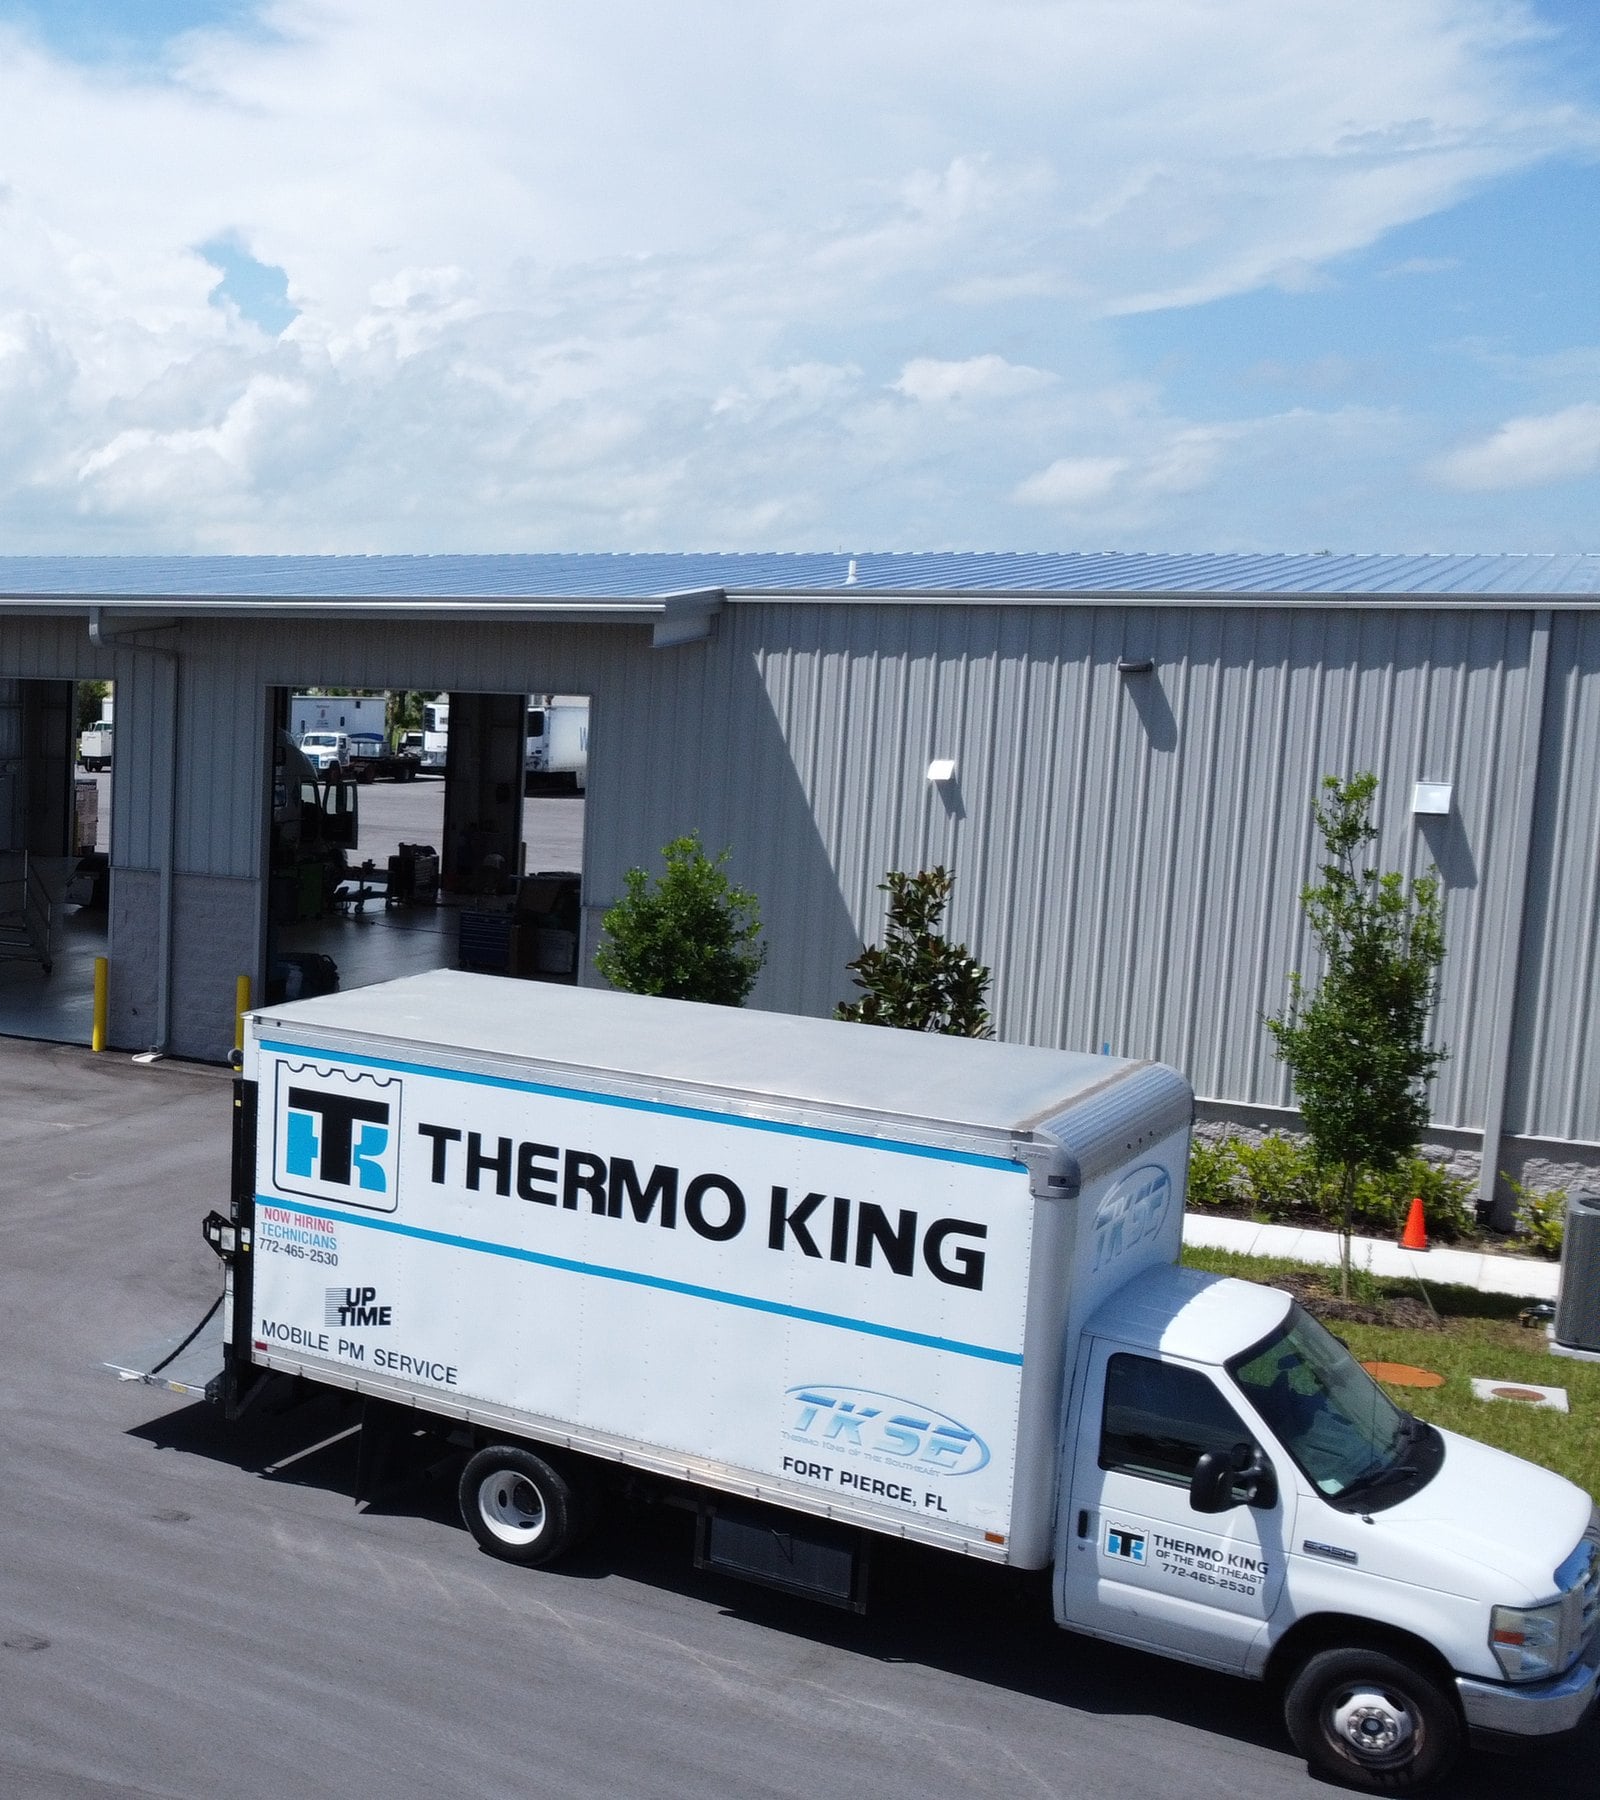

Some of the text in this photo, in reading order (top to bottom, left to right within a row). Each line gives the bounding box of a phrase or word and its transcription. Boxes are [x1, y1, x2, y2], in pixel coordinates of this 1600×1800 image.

[264, 1207, 335, 1234] NOW HIRING
[418, 1122, 988, 1291] THERMO KING
[259, 1237, 339, 1267] 772-465-2530
[261, 1222, 337, 1251] TECHNICIANS
[345, 1287, 377, 1307] UP
[337, 1306, 392, 1327] TIME
[262, 1319, 459, 1385] MOBILE PM SERVICE
[782, 1456, 948, 1512] FORT PIERCE, FL
[1152, 1534, 1270, 1575] THERMO KING
[1156, 1549, 1266, 1585] OF THE SOUTHEAST
[1161, 1562, 1256, 1597] 772-465-2530
